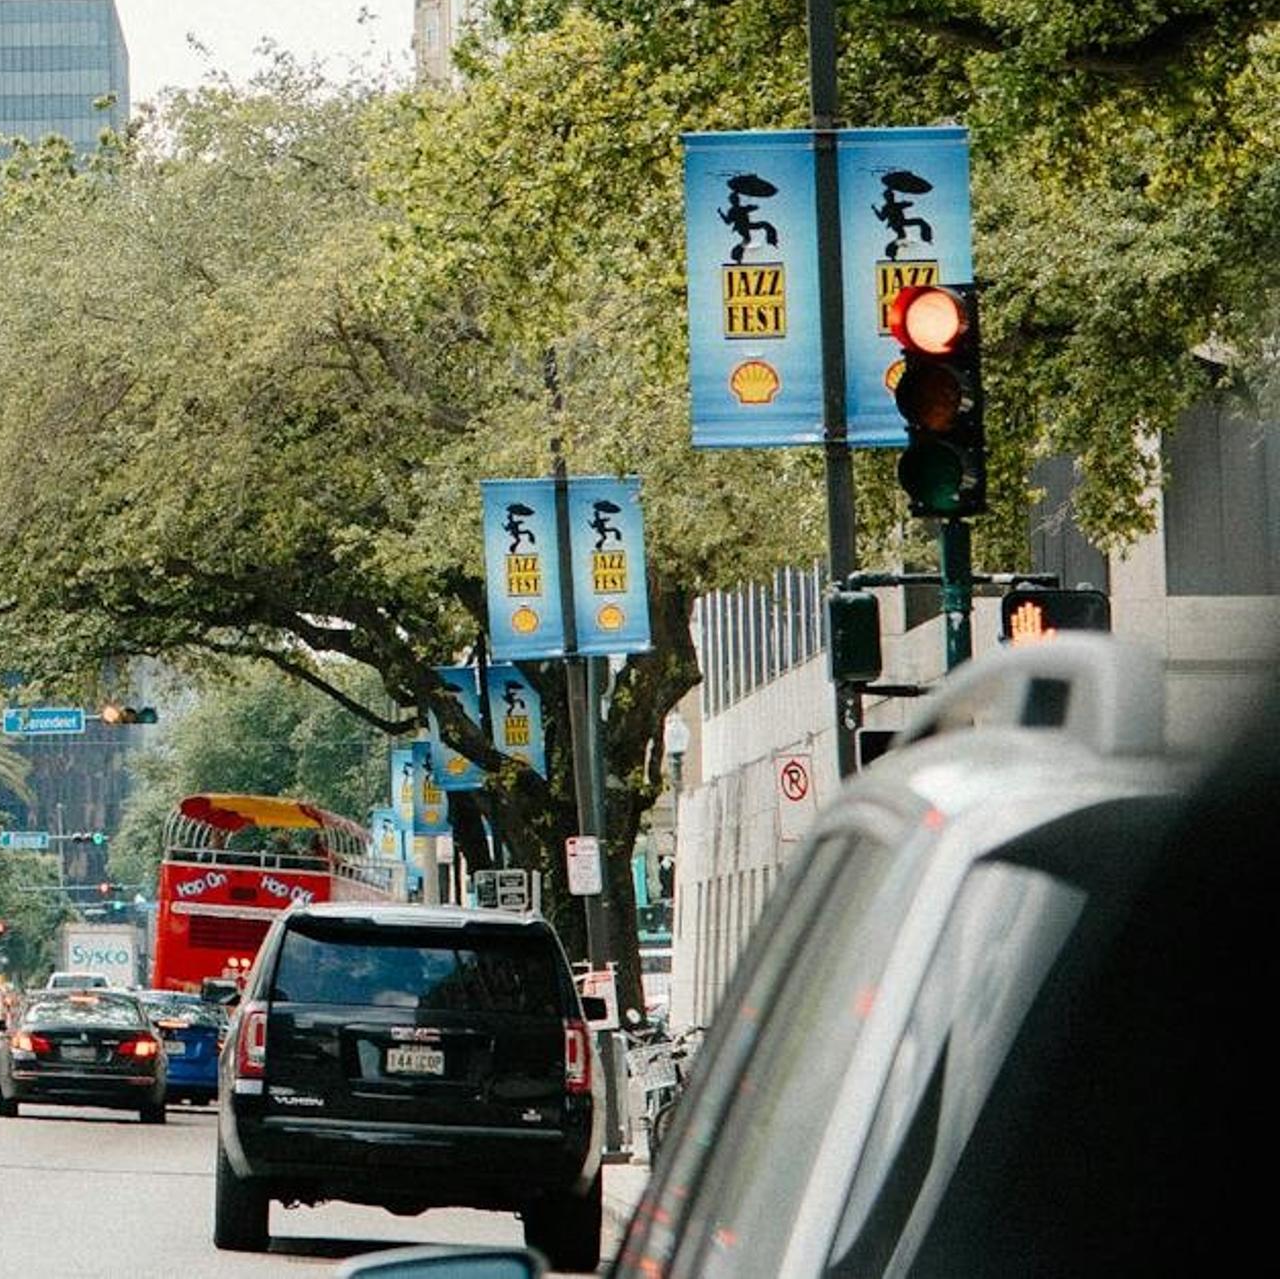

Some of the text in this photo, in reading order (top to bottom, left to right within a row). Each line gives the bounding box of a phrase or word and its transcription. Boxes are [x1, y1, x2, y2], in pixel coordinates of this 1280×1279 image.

[726, 269, 783, 300] JAZZ
[727, 304, 783, 332] FEST
[176, 872, 228, 897] Hop On
[260, 874, 315, 905] Hop Off
[72, 945, 129, 967] Sysco
